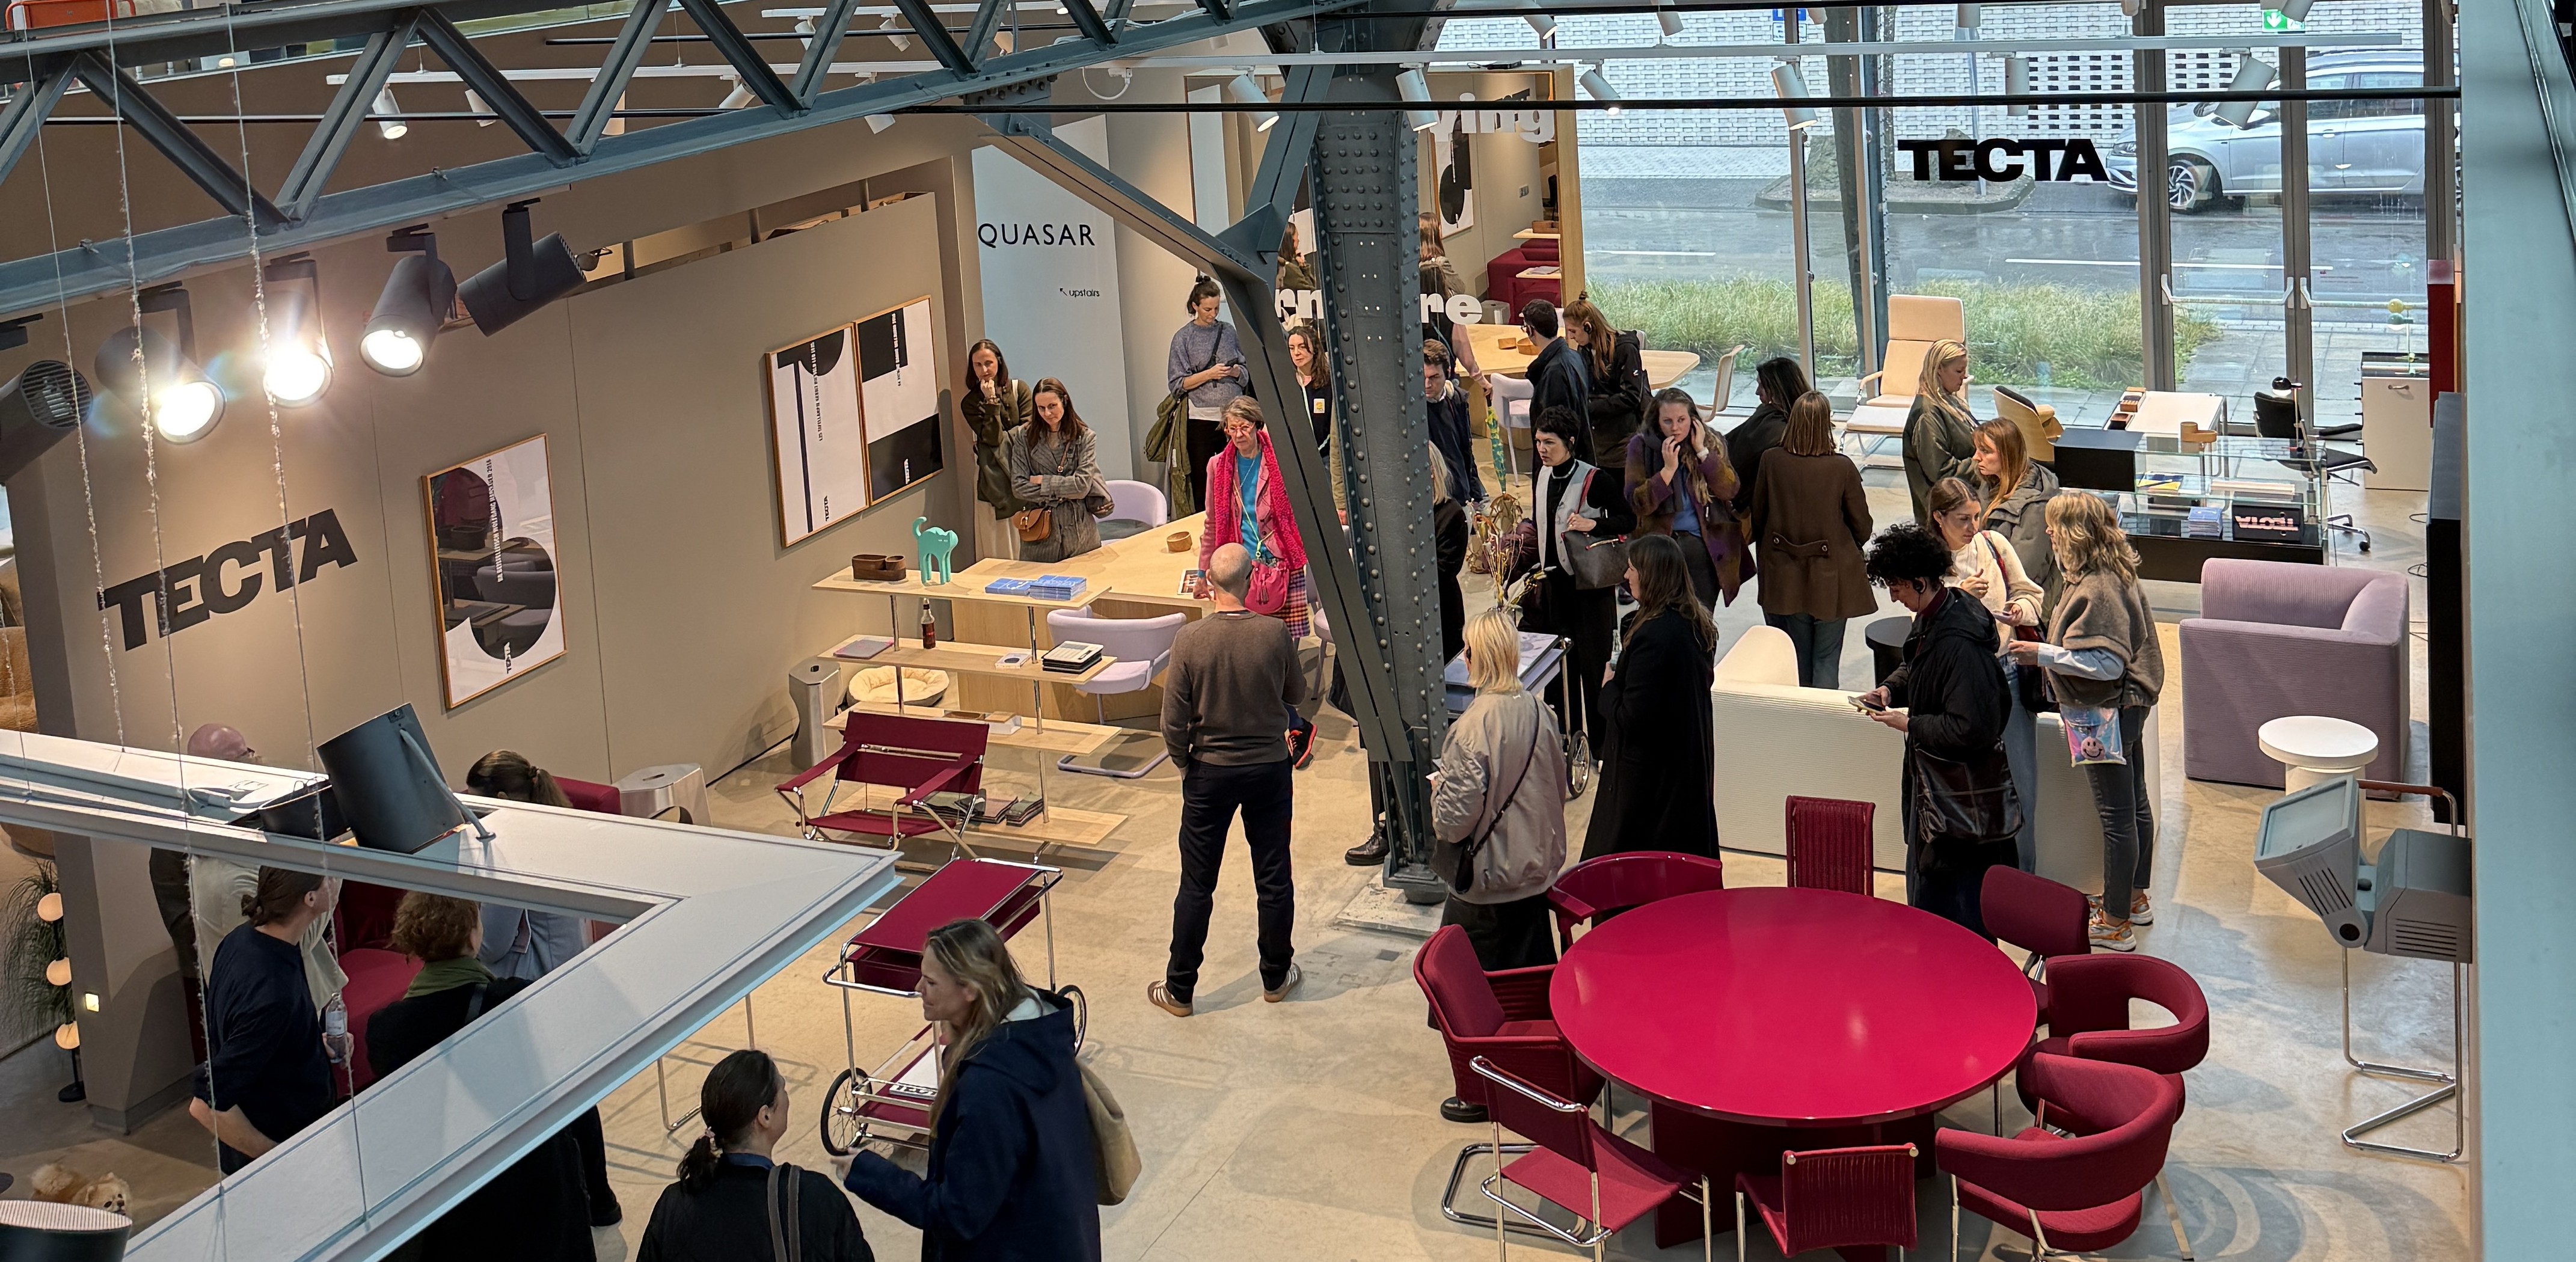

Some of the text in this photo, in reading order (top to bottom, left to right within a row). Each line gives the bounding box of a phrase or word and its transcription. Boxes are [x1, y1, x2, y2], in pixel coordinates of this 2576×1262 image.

[1897, 138, 2110, 182] TECTA
[978, 223, 1096, 248] QUASAR
[1069, 289, 1100, 298] upstairs
[96, 508, 358, 652] TECTA
[897, 1082, 938, 1096] TECT
